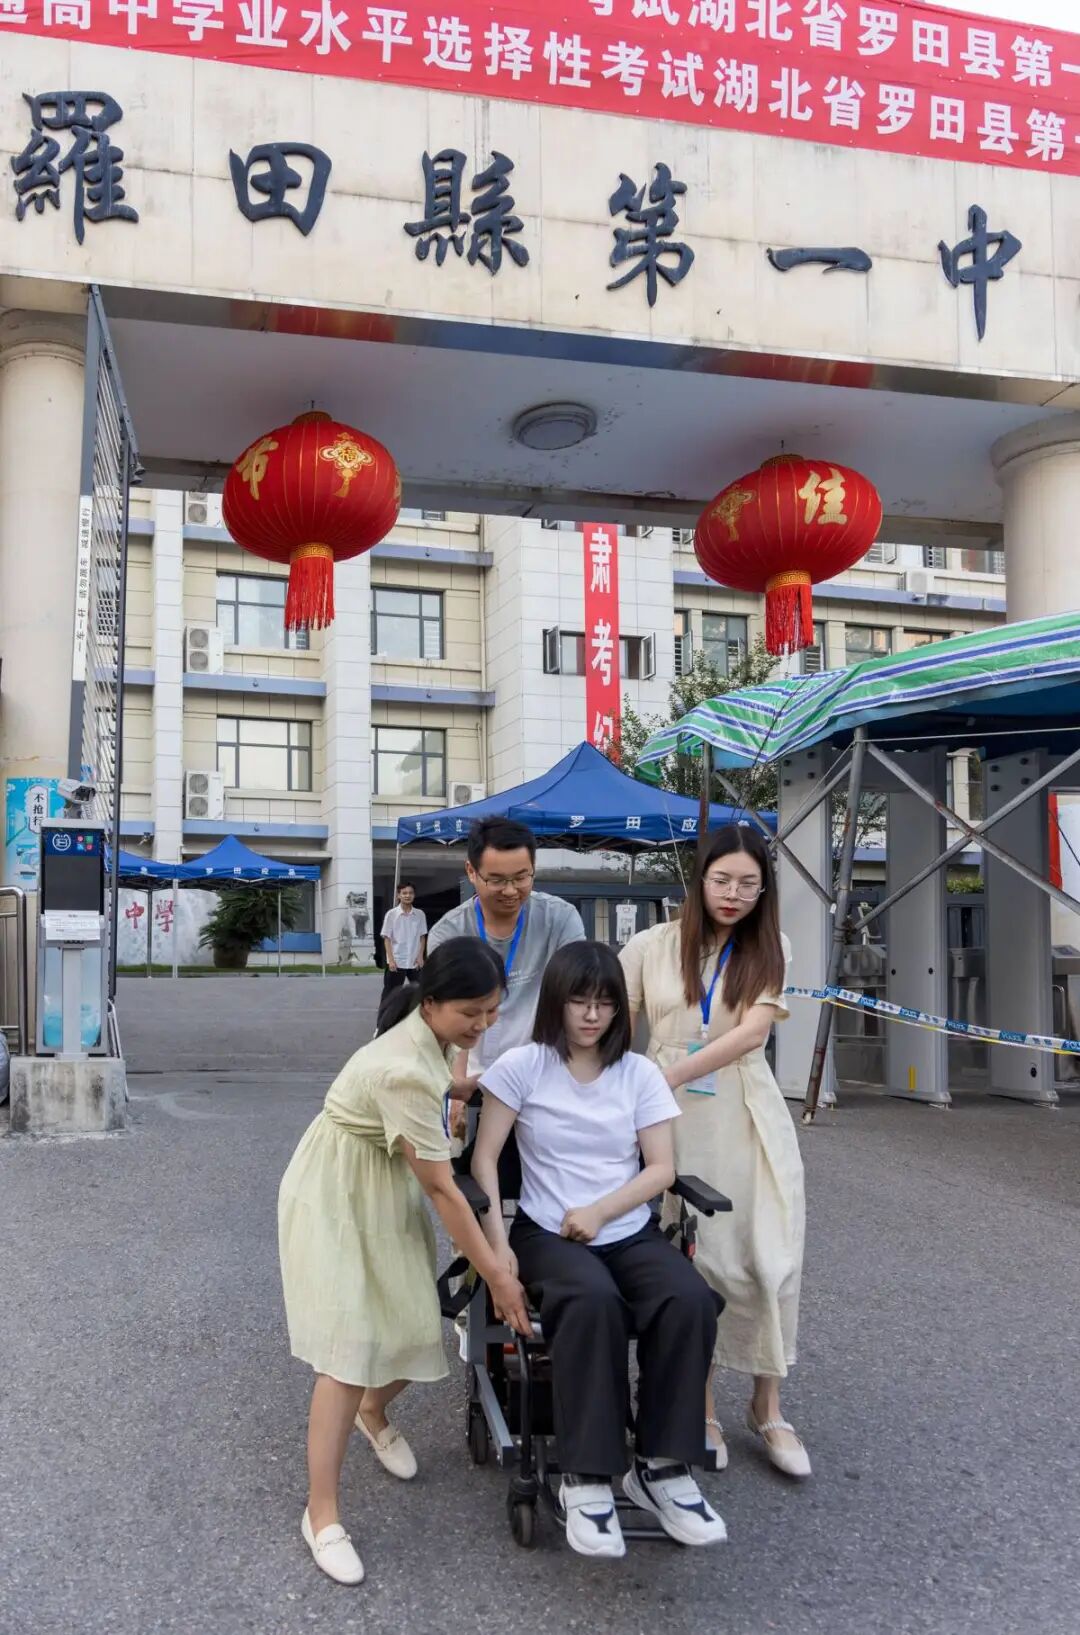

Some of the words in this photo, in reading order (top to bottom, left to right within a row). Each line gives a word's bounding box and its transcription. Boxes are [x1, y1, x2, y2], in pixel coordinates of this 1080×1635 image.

[0, 0, 1080, 162] 高中学业水平选择性考试湖北省罗田县第
[798, 467, 848, 525] 佳
